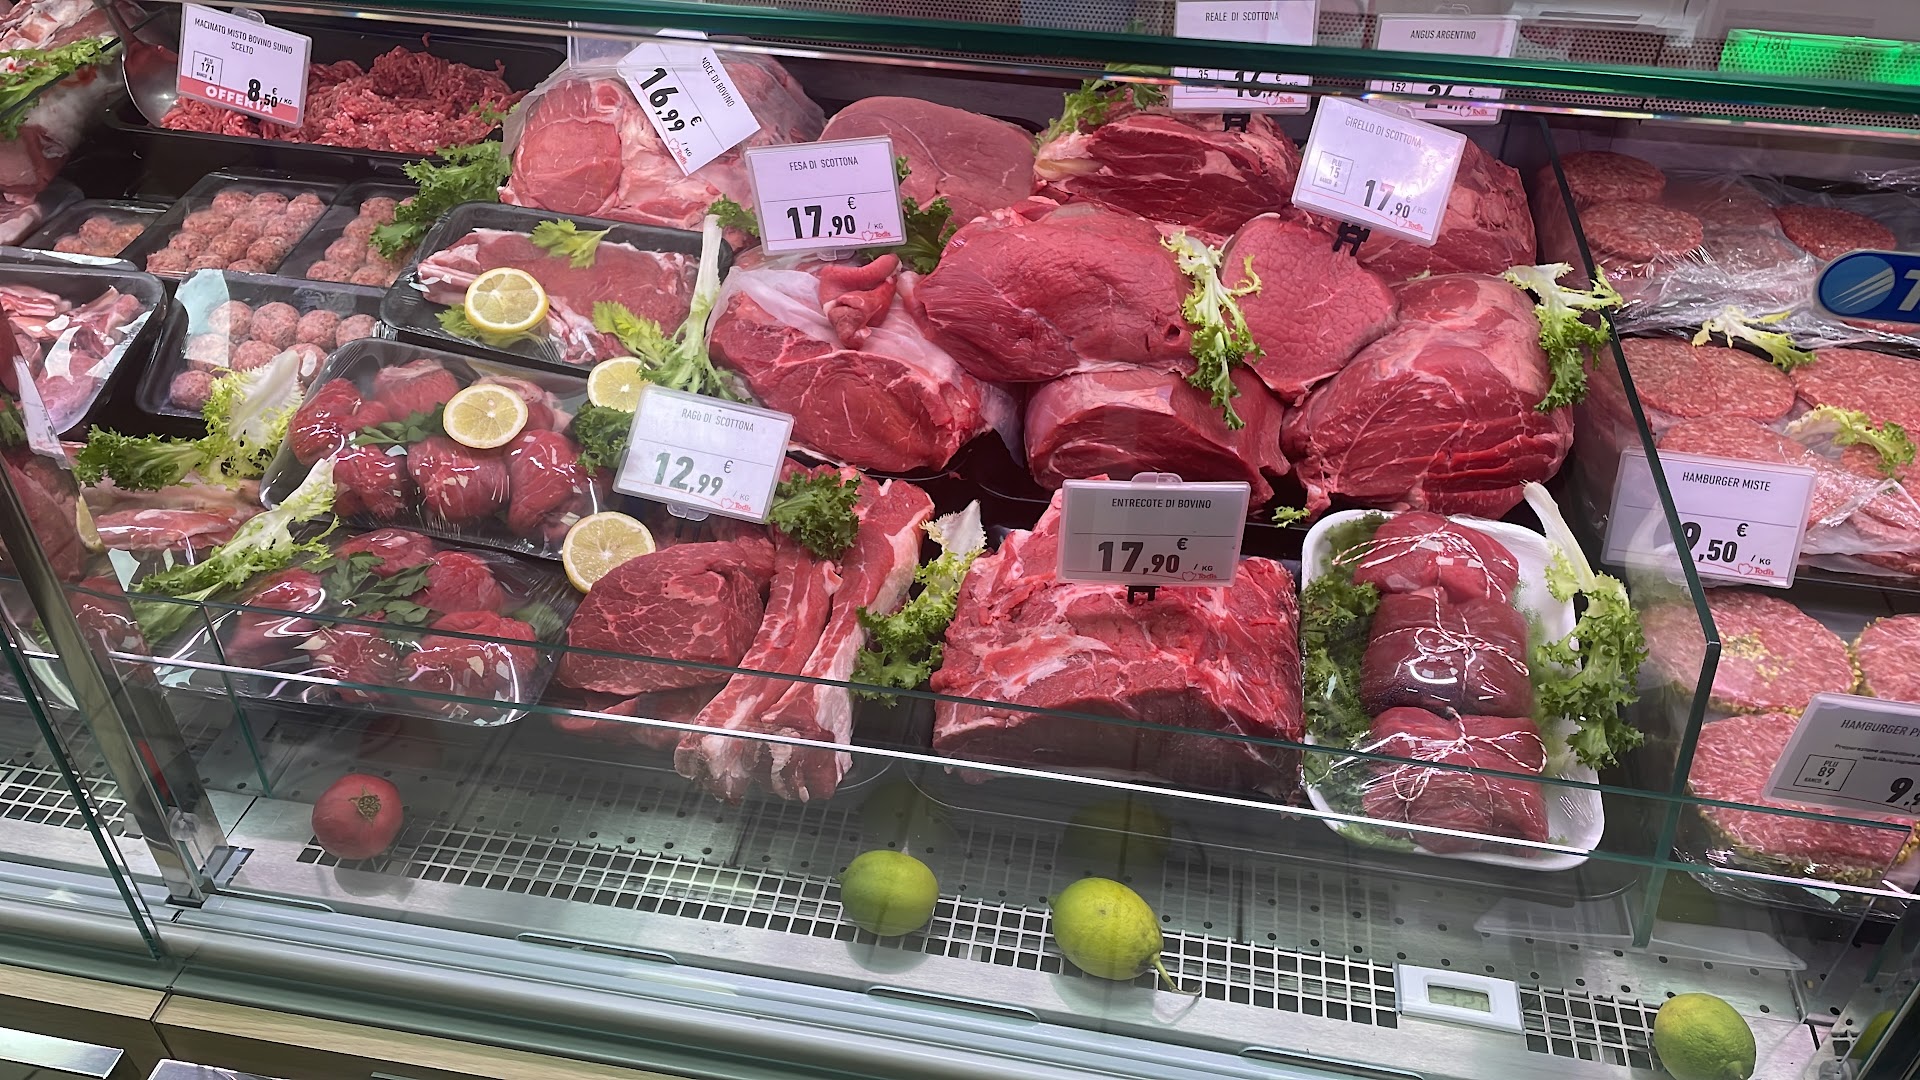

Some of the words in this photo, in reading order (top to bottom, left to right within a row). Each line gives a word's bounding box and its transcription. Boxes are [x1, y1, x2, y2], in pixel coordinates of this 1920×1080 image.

[1206, 12, 1227, 22] REALE
[1232, 12, 1239, 21] DI
[1242, 12, 1279, 21] SCOTTONA
[195, 18, 226, 34] MACINATO
[227, 28, 246, 41] MISTO
[248, 35, 271, 48] BOVINO
[273, 42, 292, 54] SUINO
[1410, 30, 1434, 39] ANGUS
[1436, 30, 1476, 39] ARGENTINO
[231, 42, 253, 54] SCELTO
[201, 62, 214, 74] 171
[702, 57, 716, 76] NOCE
[711, 74, 720, 83] DI
[716, 82, 735, 108] BOVINO
[1391, 82, 1406, 92] 152
[247, 78, 278, 107] 8,50
[272, 87, 278, 95] €
[640, 68, 685, 132] 16,99
[690, 116, 702, 126] €
[1345, 116, 1375, 134] GIRELLO
[1376, 125, 1384, 135] DI
[1385, 128, 1422, 148] SCOTTONA
[789, 161, 808, 171] FESA
[809, 160, 817, 169] DI
[820, 156, 858, 168] SCOTTONA
[1332, 159, 1342, 167] PLU
[1330, 166, 1340, 178] 15
[1364, 180, 1411, 218] 17,90
[787, 205, 856, 239] 17,90
[848, 197, 856, 209] €
[704, 414, 712, 423] DI
[715, 416, 754, 432] SCOTTONA
[653, 452, 723, 496] 12,99
[724, 460, 733, 474] €
[740, 494, 750, 502] KG
[1682, 472, 1740, 488] HAMBURGER
[1742, 480, 1771, 491] MISTE
[735, 502, 751, 512] Todis
[1112, 498, 1163, 508] ENTRECOTE
[1166, 499, 1175, 508] DI
[1177, 499, 1211, 509] BOVINO
[1737, 523, 1749, 537] €
[1098, 542, 1180, 575] 17,90
[1177, 538, 1188, 550] €
[1754, 566, 1774, 576] Todis
[1840, 720, 1908, 736] HAMBURGER
[1817, 767, 1835, 778] 89
